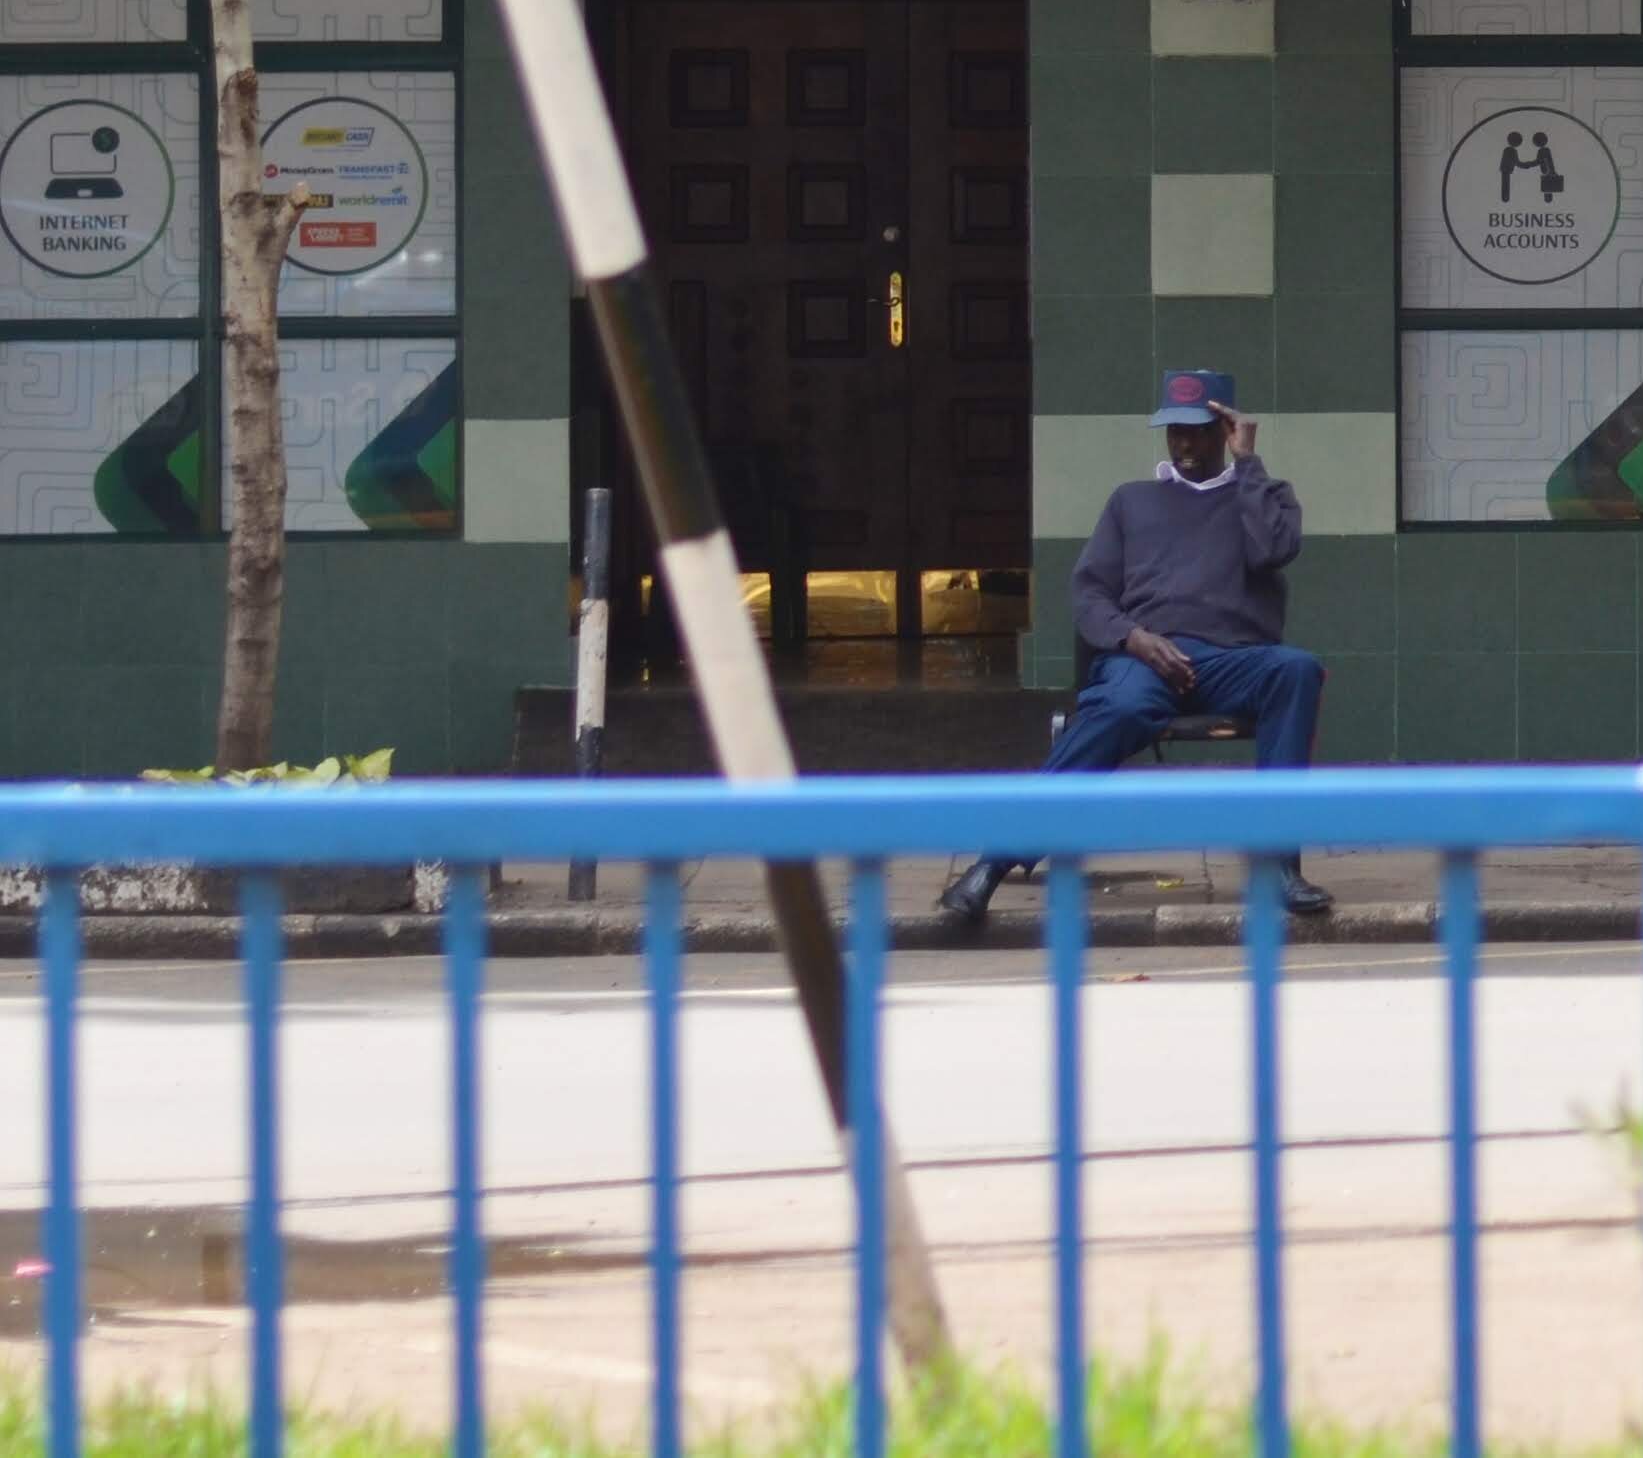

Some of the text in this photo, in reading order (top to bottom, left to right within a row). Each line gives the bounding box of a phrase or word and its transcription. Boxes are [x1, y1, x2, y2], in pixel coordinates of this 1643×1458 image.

[39, 214, 130, 231] INTERNET
[1488, 212, 1575, 228] BUSINESS
[42, 235, 127, 253] BANKING
[1483, 232, 1580, 250] ACCOUNTS
